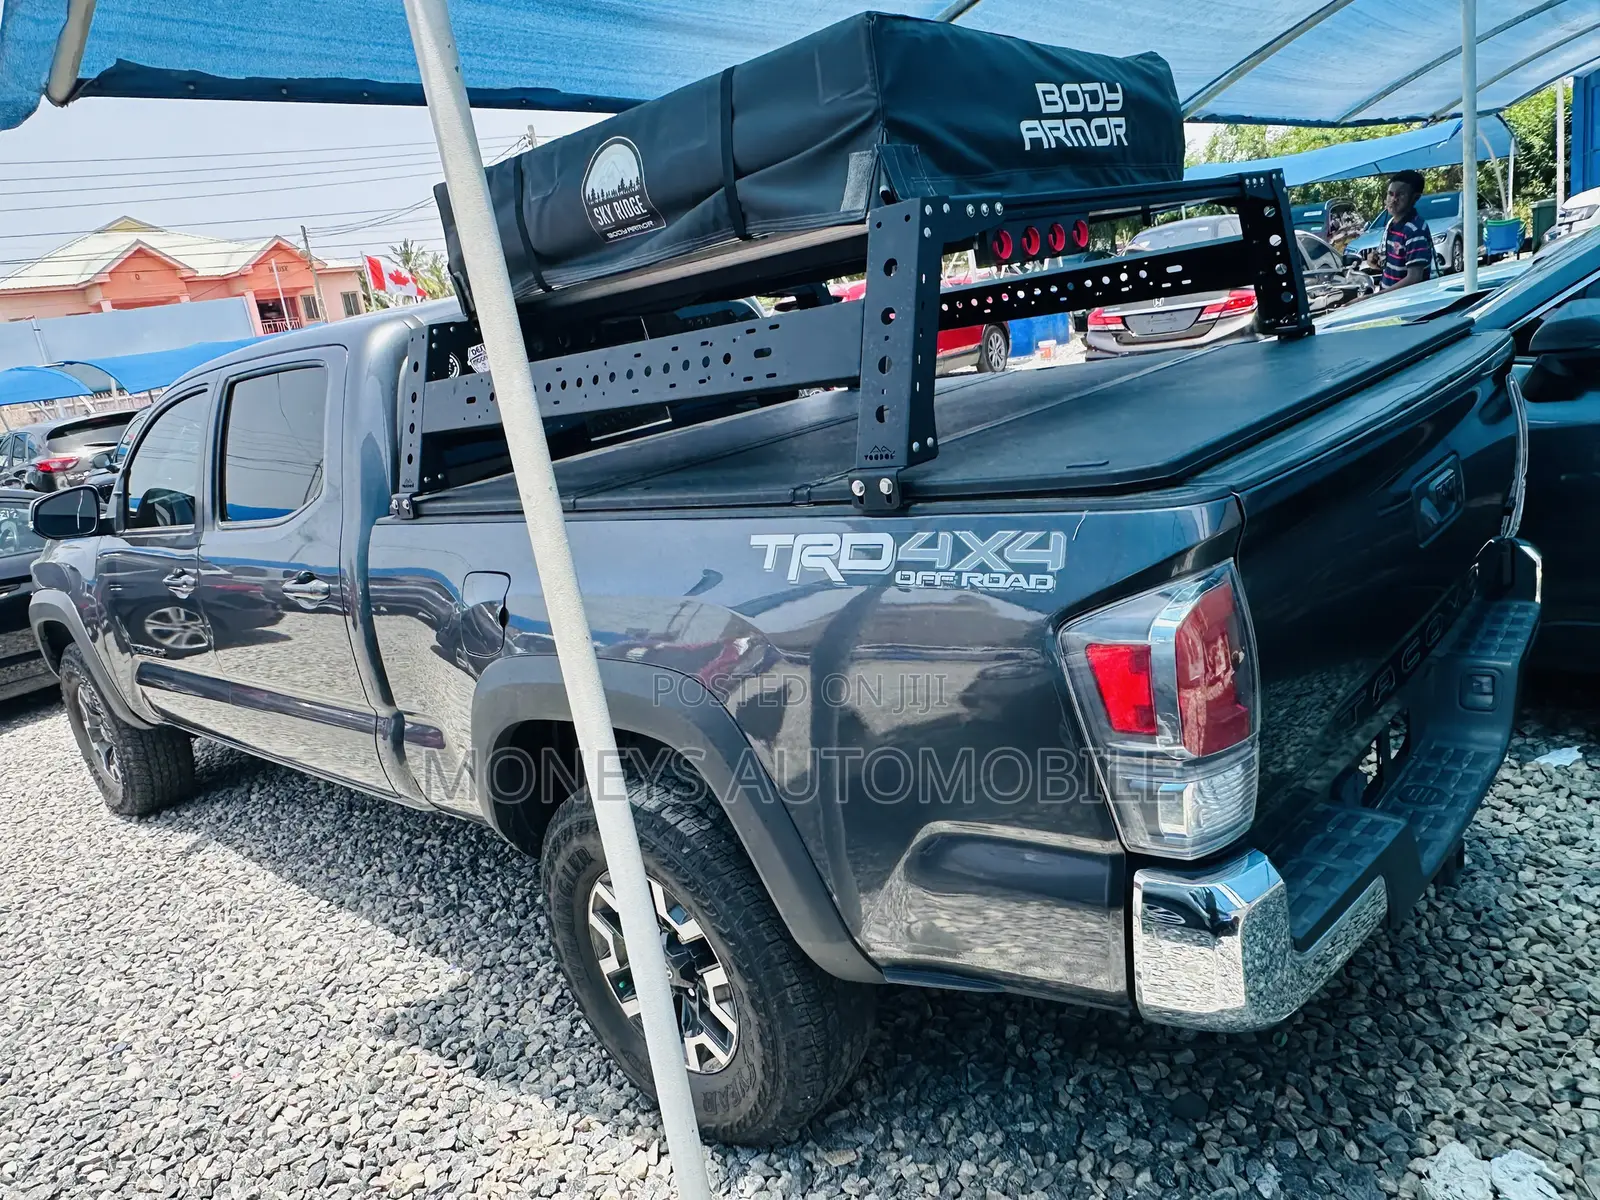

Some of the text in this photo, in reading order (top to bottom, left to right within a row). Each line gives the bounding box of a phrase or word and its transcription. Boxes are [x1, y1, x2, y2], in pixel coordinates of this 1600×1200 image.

[1035, 82, 1123, 113] BODY
[1020, 117, 1128, 151] ARMOR
[593, 195, 647, 226] SKY RIDGE
[607, 220, 655, 239] BODY ARMOR
[268, 265, 288, 273] HUSE
[750, 530, 1067, 585] TRD 4X4
[894, 570, 1056, 592] OFF ROAD
